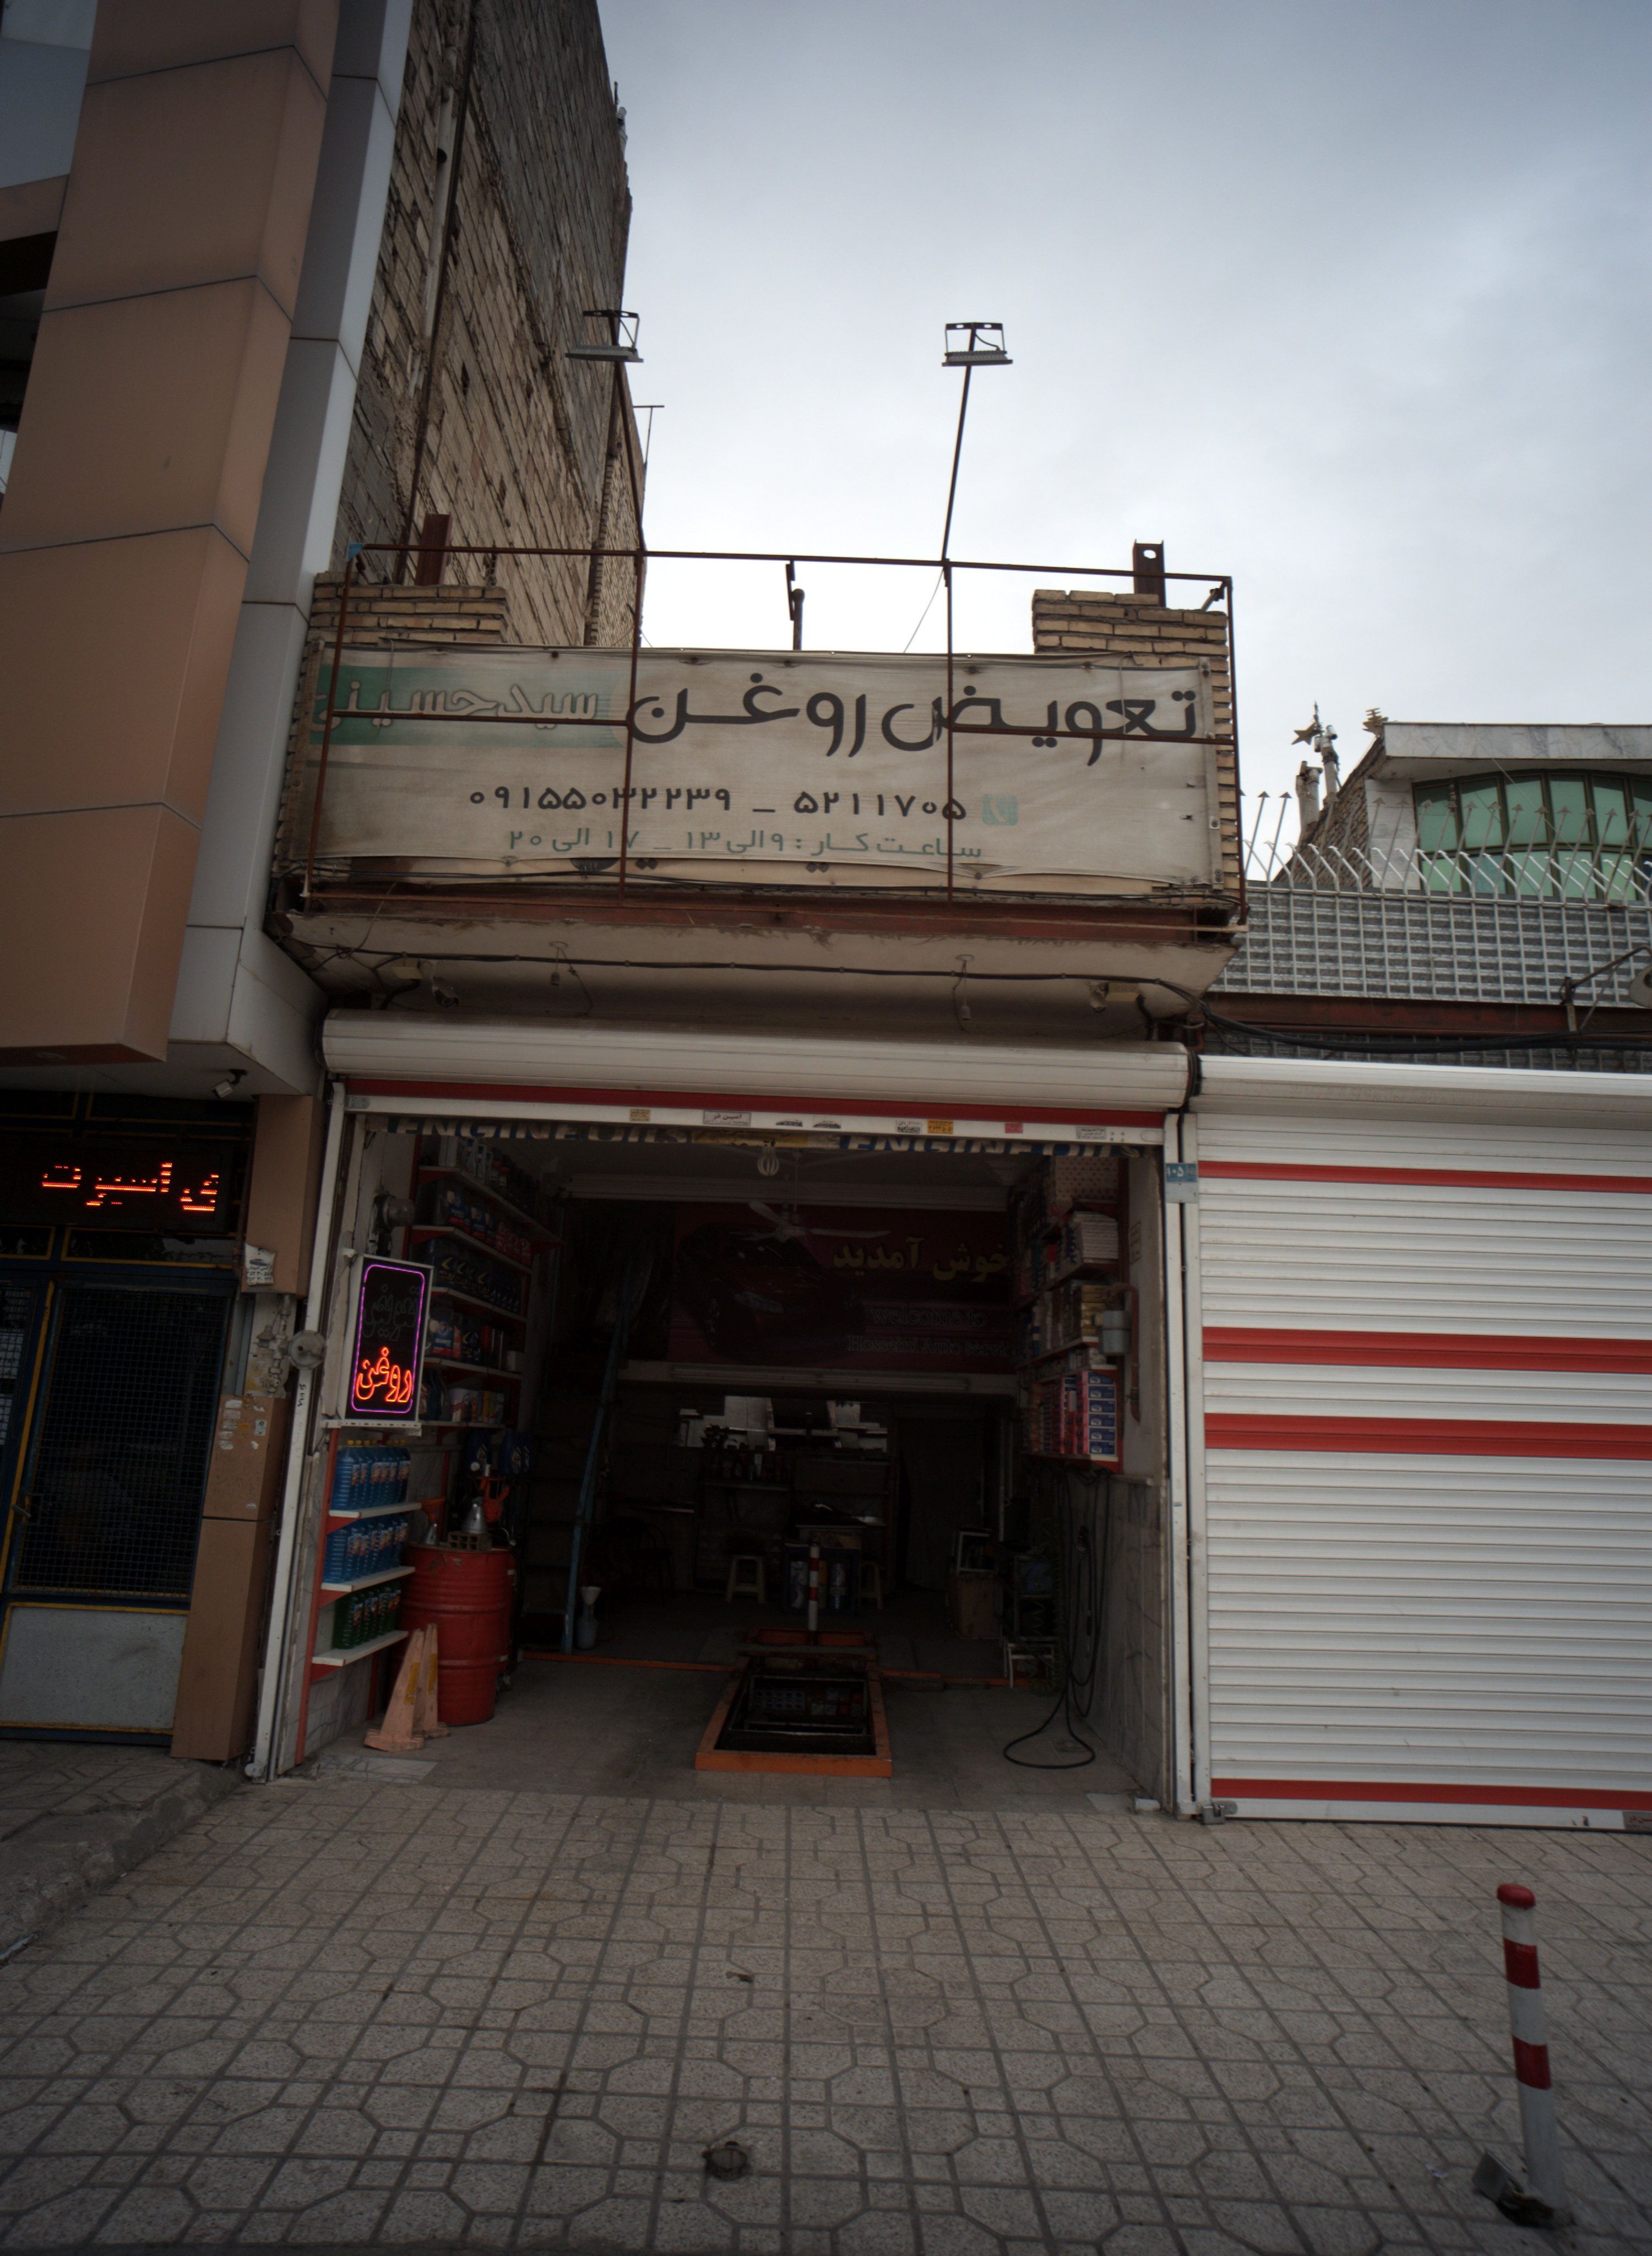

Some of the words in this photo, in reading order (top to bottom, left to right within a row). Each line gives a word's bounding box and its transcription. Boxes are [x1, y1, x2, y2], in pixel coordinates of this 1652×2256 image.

[627, 673, 866, 758] روغن
[882, 685, 1197, 766] تعویض
[470, 785, 731, 811] ۰۹۱۵۵۰۳۲۲۳۹
[794, 791, 967, 820] ۵۲۱۱۷۰۵
[876, 837, 981, 858] ساعت
[833, 1236, 926, 1277] آمدید
[933, 1242, 1010, 1282] خوش
[355, 1346, 412, 1403] روغن
